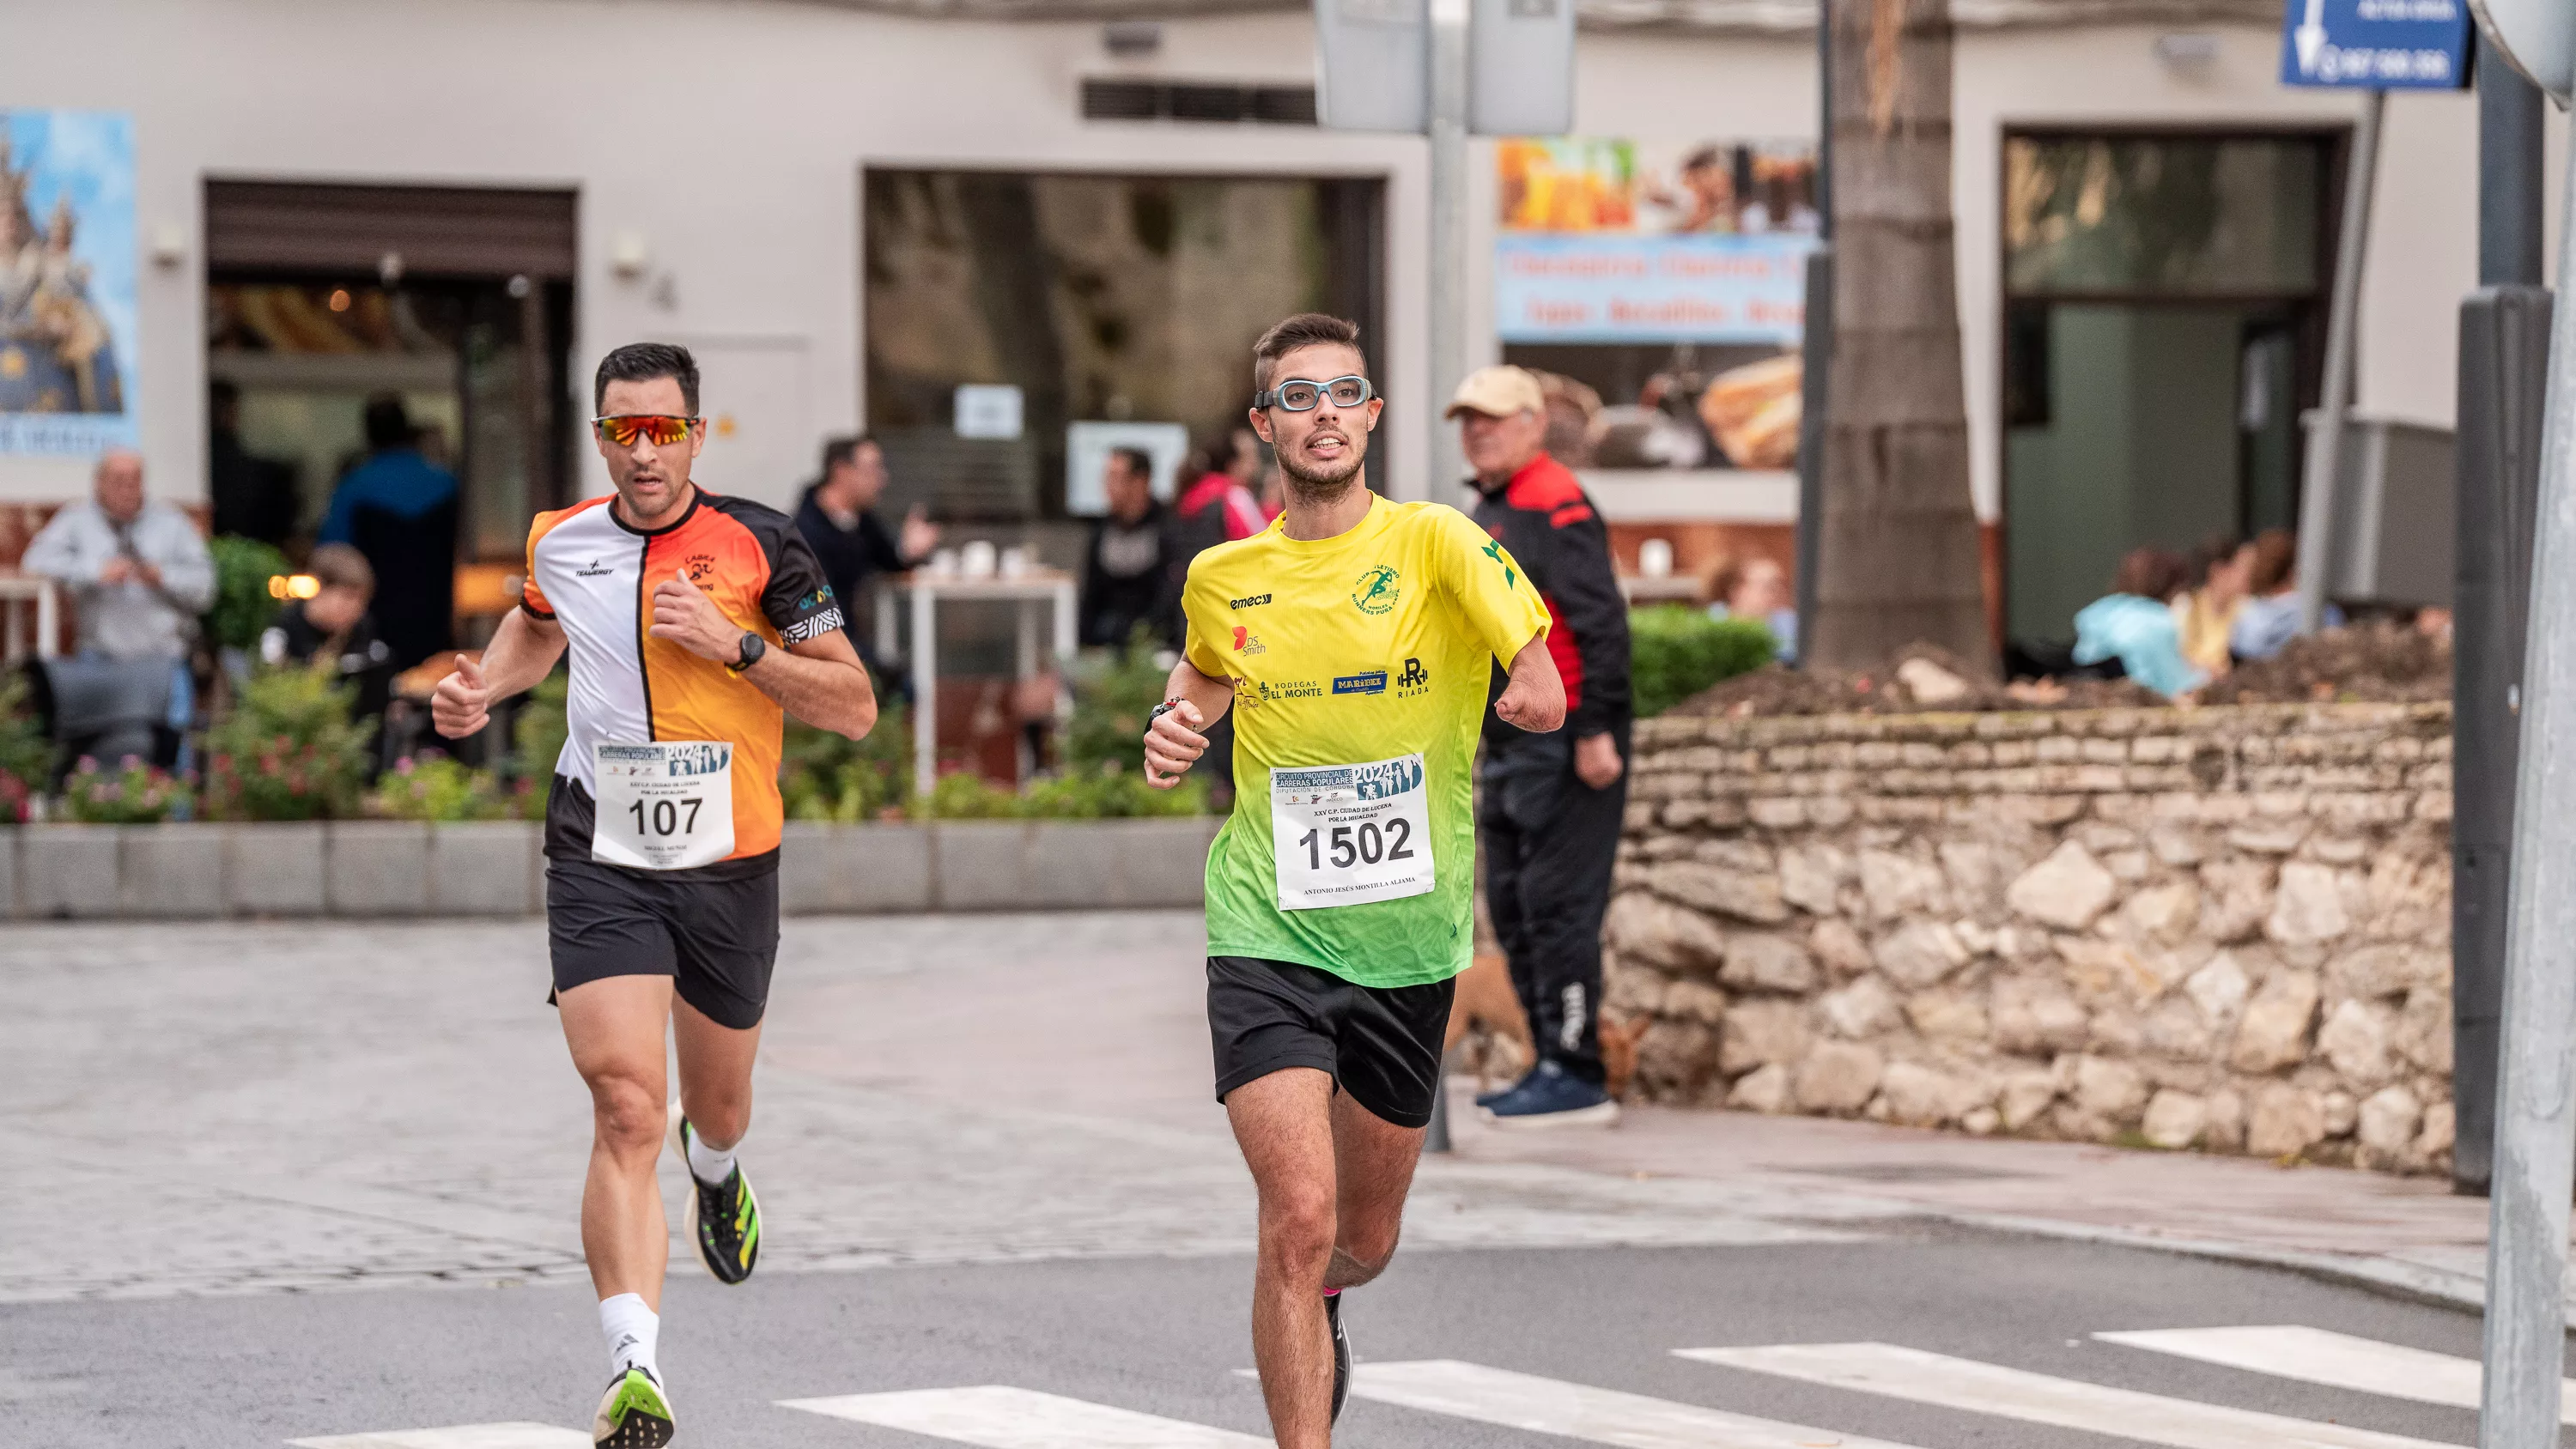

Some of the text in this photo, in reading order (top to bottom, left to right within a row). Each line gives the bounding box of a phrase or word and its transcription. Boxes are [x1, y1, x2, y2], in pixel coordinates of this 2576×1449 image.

[1352, 594, 1374, 615] RUNNERS
[1376, 606, 1393, 615] PURA
[1247, 636, 1258, 647] DS
[1242, 644, 1266, 657] Smith
[1275, 681, 1317, 689] BODEGAS
[1271, 688, 1323, 700] EL MONTE
[1398, 687, 1429, 699] RIADA
[668, 745, 702, 761] 2024
[1303, 770, 1342, 779] PROVINCIAL
[1355, 764, 1394, 783] 2024
[1312, 776, 1353, 785] POPULARES
[1370, 803, 1392, 811] LUCENA
[629, 797, 702, 835] 107
[1348, 812, 1378, 822] IGUALDAD
[1299, 817, 1414, 870] 1502
[1355, 881, 1388, 890] MONTILLA
[1389, 876, 1416, 886] ALJAMA
